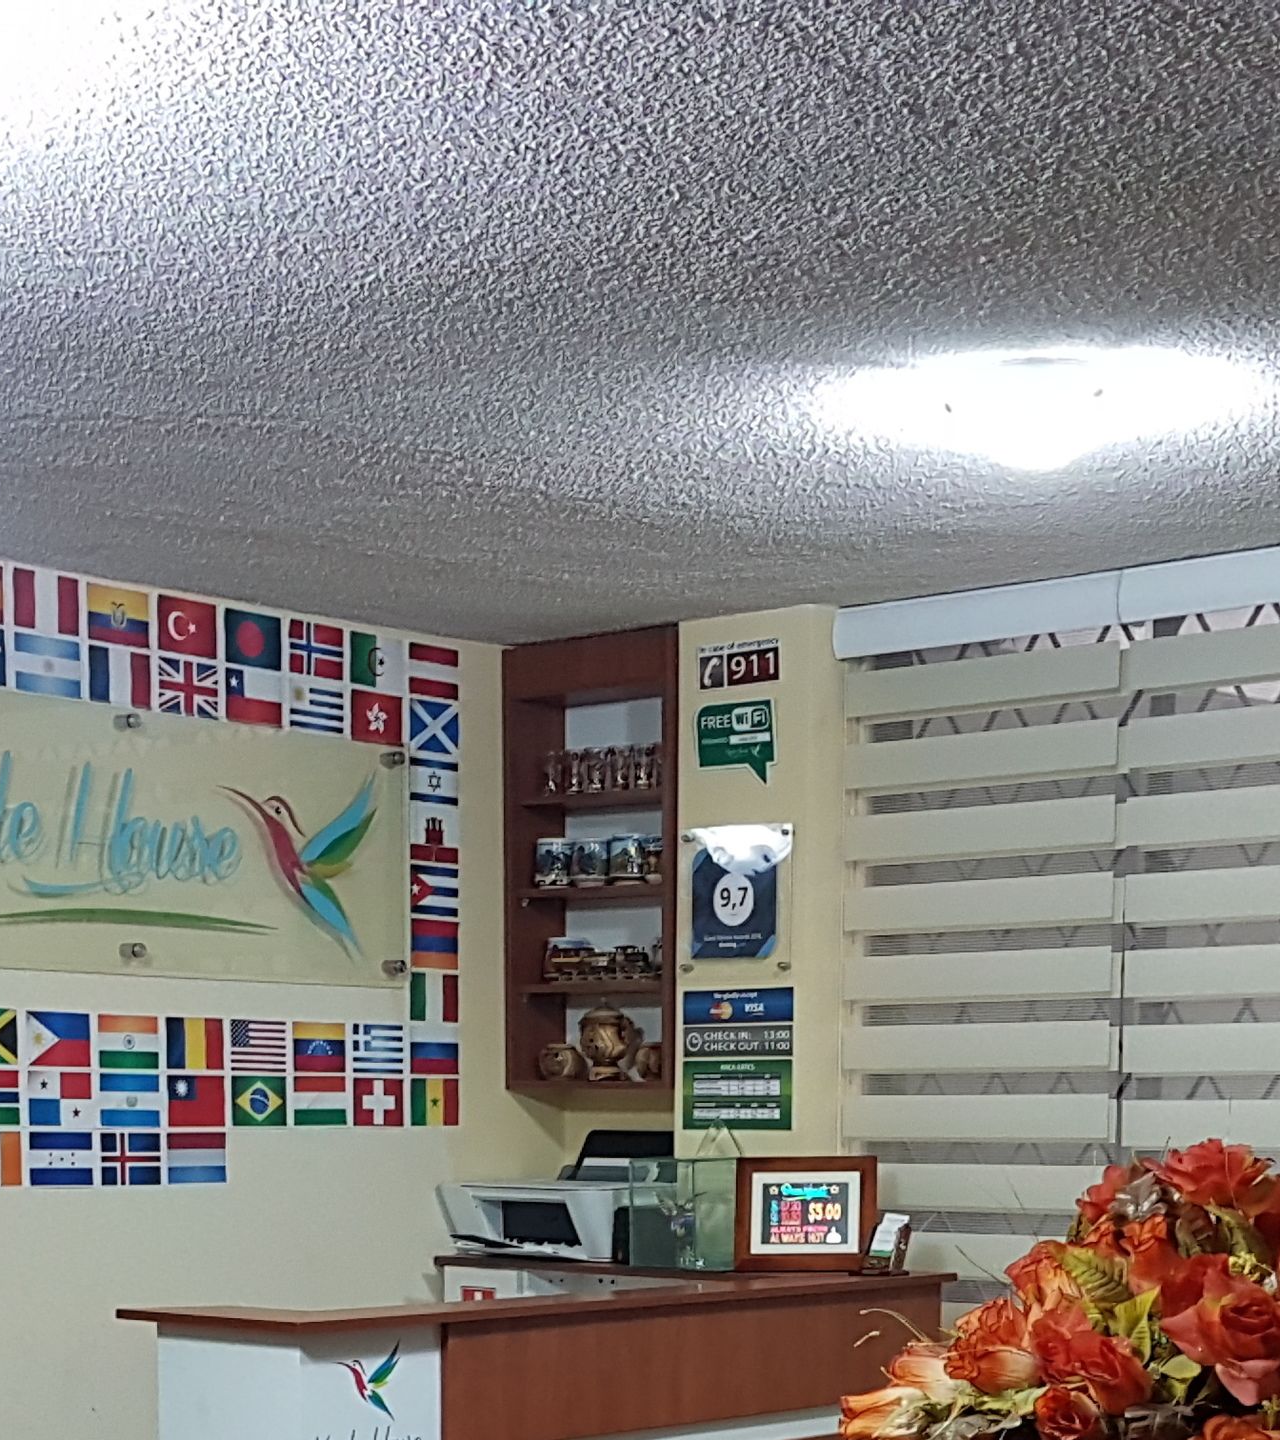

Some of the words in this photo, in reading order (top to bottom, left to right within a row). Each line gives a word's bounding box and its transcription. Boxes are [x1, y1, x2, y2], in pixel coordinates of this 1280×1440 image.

[731, 651, 776, 680] 911
[701, 714, 731, 729] FREE
[24, 760, 241, 894] House
[720, 887, 749, 910] 9,7
[744, 1003, 764, 1012] VISA
[704, 1032, 735, 1041] CHECK
[704, 1042, 736, 1051] CHECK
[764, 1041, 790, 1050] 11:00
